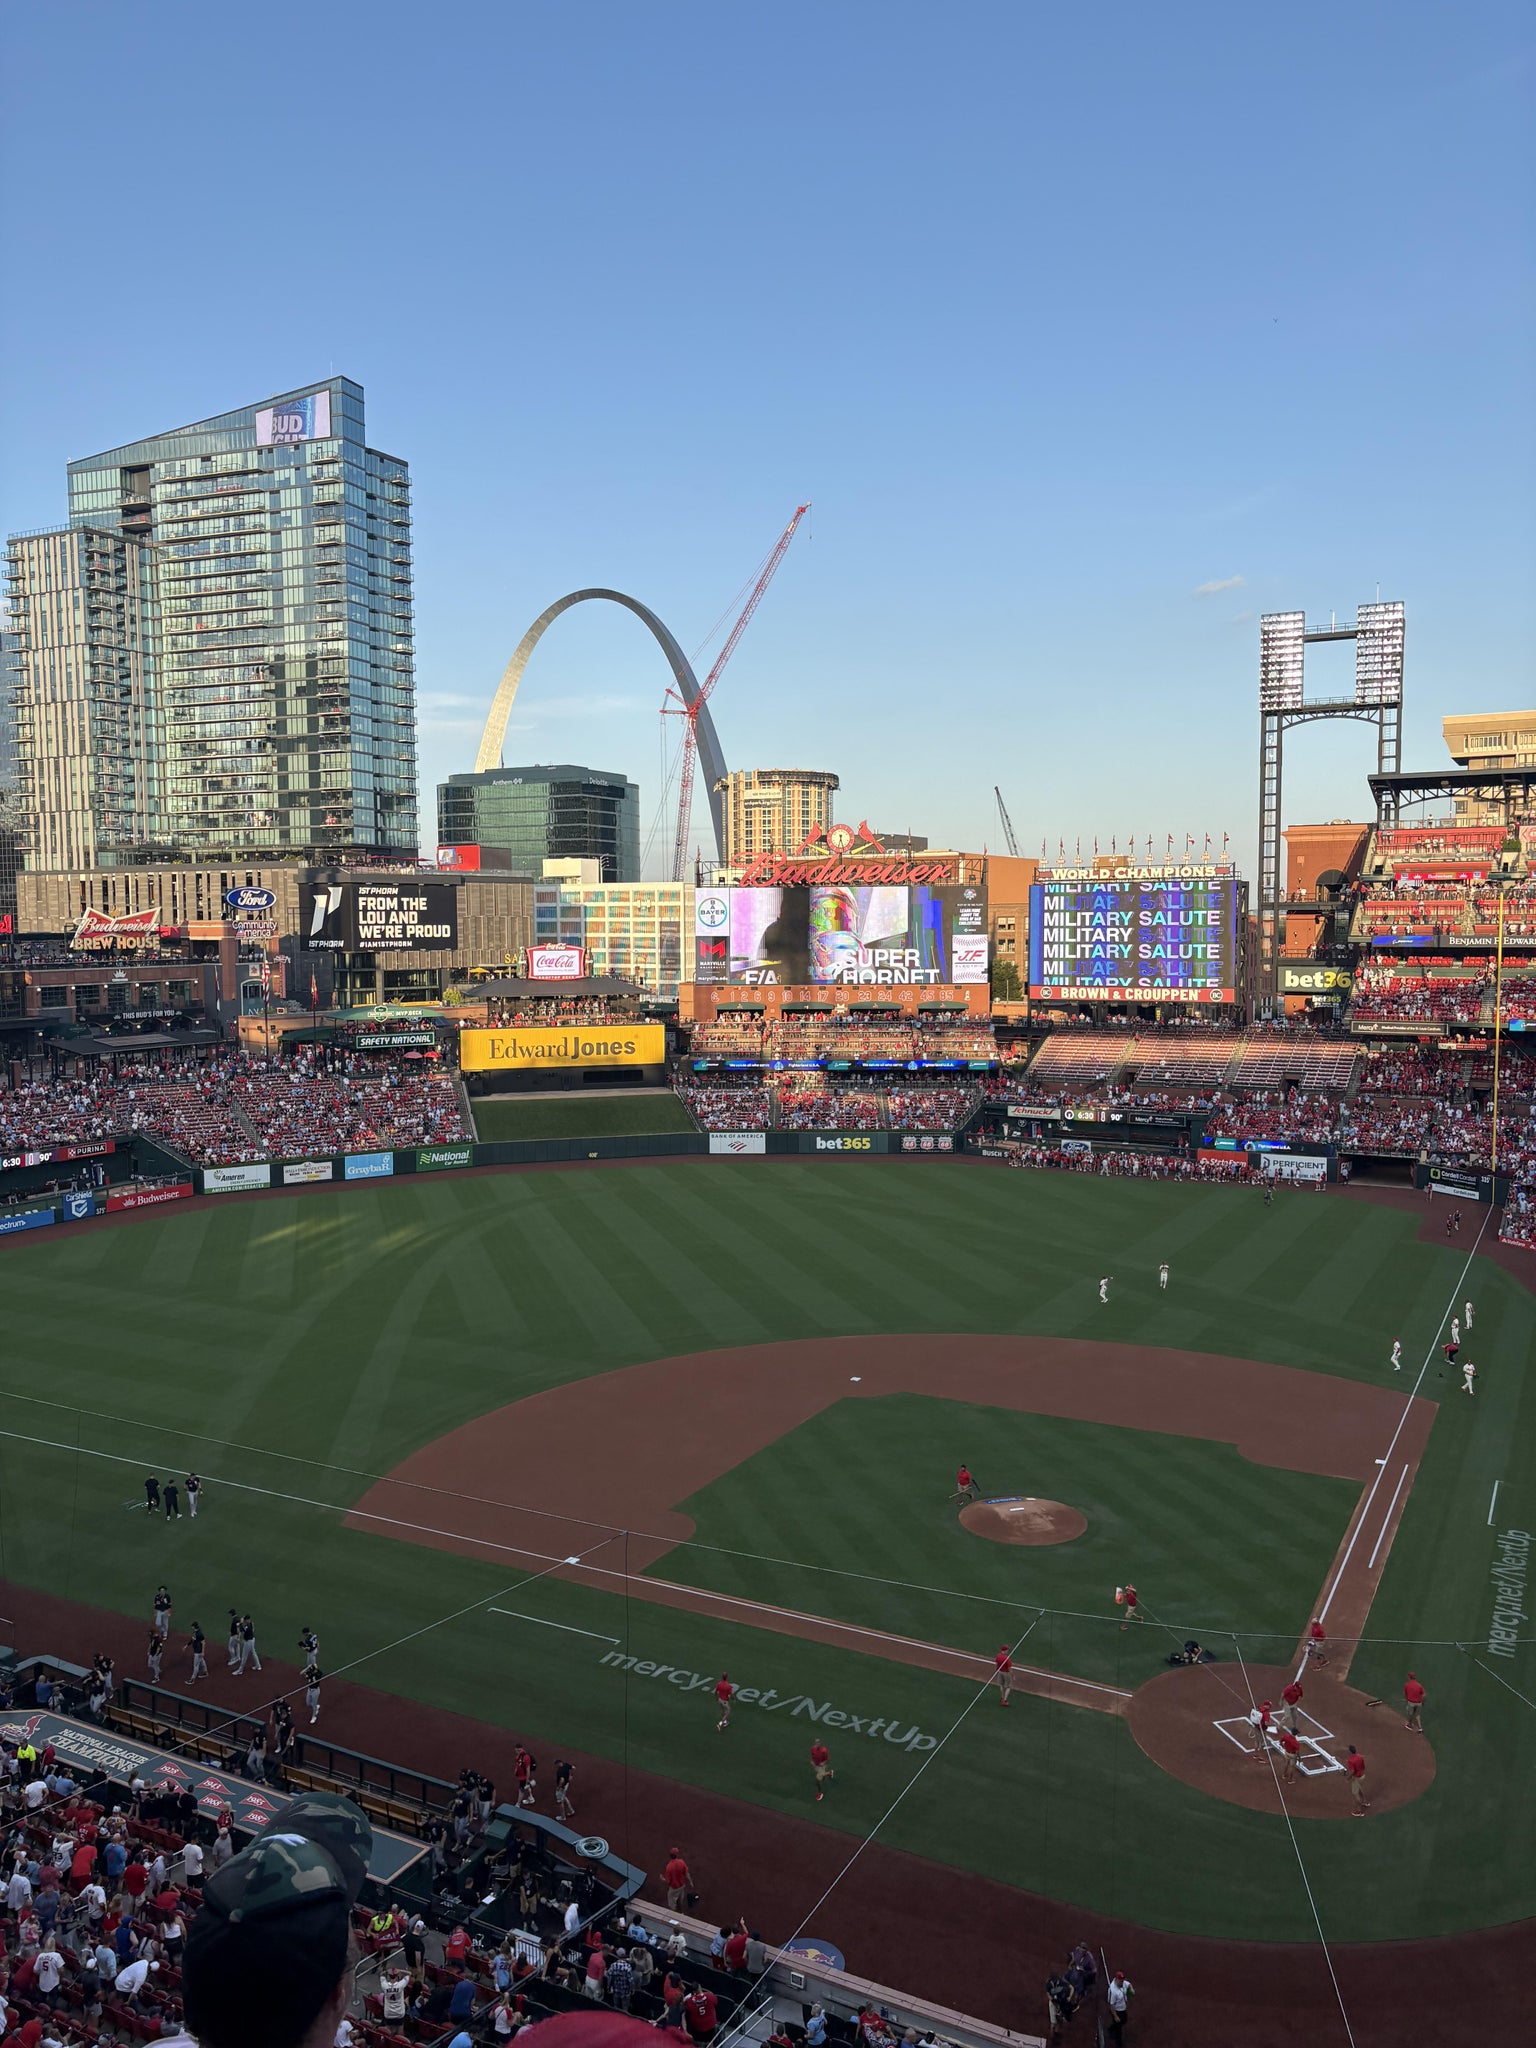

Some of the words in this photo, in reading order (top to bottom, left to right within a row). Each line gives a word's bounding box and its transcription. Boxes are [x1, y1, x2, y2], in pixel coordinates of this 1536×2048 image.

[272, 415, 302, 434] BUD
[732, 852, 952, 887] Budweiser
[1051, 868, 1110, 880] WORLD
[1114, 866, 1216, 879] CHAMPIONS
[238, 890, 267, 905] Ford
[359, 897, 398, 910] FROM
[401, 898, 427, 910] THE
[359, 911, 385, 924] LOU
[389, 911, 418, 924] AND
[1044, 911, 1134, 926] MILITARY
[1139, 911, 1221, 926] SALUTE
[73, 918, 160, 934] Budweiser
[232, 920, 278, 930] Community
[359, 925, 403, 938] WE'RE
[407, 925, 450, 938] PROUD
[1044, 928, 1134, 942] MILITARY
[1449, 937, 1492, 946] BENJAMIN
[74, 937, 113, 950] BREW
[117, 936, 160, 949] HOUSE
[844, 949, 920, 967] SUPER
[1044, 944, 1133, 959] MILITARY
[1138, 944, 1221, 958] SALUTE
[843, 969, 940, 984] HORNET
[741, 991, 748, 1002] 2
[754, 991, 761, 1002] 6
[768, 991, 775, 1002] 9
[782, 991, 793, 1002] 10
[800, 991, 811, 1002] 14
[817, 991, 829, 1002] 17
[835, 991, 849, 1001] 20
[858, 991, 871, 1001] 23
[878, 991, 892, 1001] 24
[899, 991, 913, 1001] 42
[920, 991, 934, 1001] 45
[940, 991, 953, 1001] 85
[1061, 988, 1109, 999] BROWN
[1113, 991, 1121, 1000] &
[1125, 989, 1199, 1000] CROUPPEN
[360, 1037, 390, 1046] SAFETY
[392, 1035, 431, 1044] NATIONAL
[489, 1036, 567, 1059] Edward
[571, 1036, 636, 1059] Jones
[1012, 1106, 1057, 1115] Schnucks
[76, 1145, 105, 1154] PURINA
[816, 1136, 870, 1150] bet365
[3, 1158, 20, 1167] 6:30
[40, 1153, 52, 1161] 90°
[432, 1150, 470, 1162] National
[1273, 1160, 1325, 1169] PERFICIENT
[220, 1174, 245, 1182] Ameren
[1442, 1171, 1459, 1179] Cordell
[65, 1191, 92, 1202] CarShield
[1487, 1530, 1530, 1658] mercy.net/NextUp
[59, 1729, 107, 1750] NATIONAL
[108, 1745, 149, 1764] LEAGUE
[48, 1735, 139, 1772] CHAMPIONS
[161, 1765, 179, 1774] 1928
[203, 1780, 221, 1789] 1943
[203, 1797, 222, 1806] 1968
[247, 1796, 264, 1806] 1985
[248, 1812, 266, 1822] 1987
[42, 1962, 48, 1971] 5
[699, 2007, 705, 2015] 5
